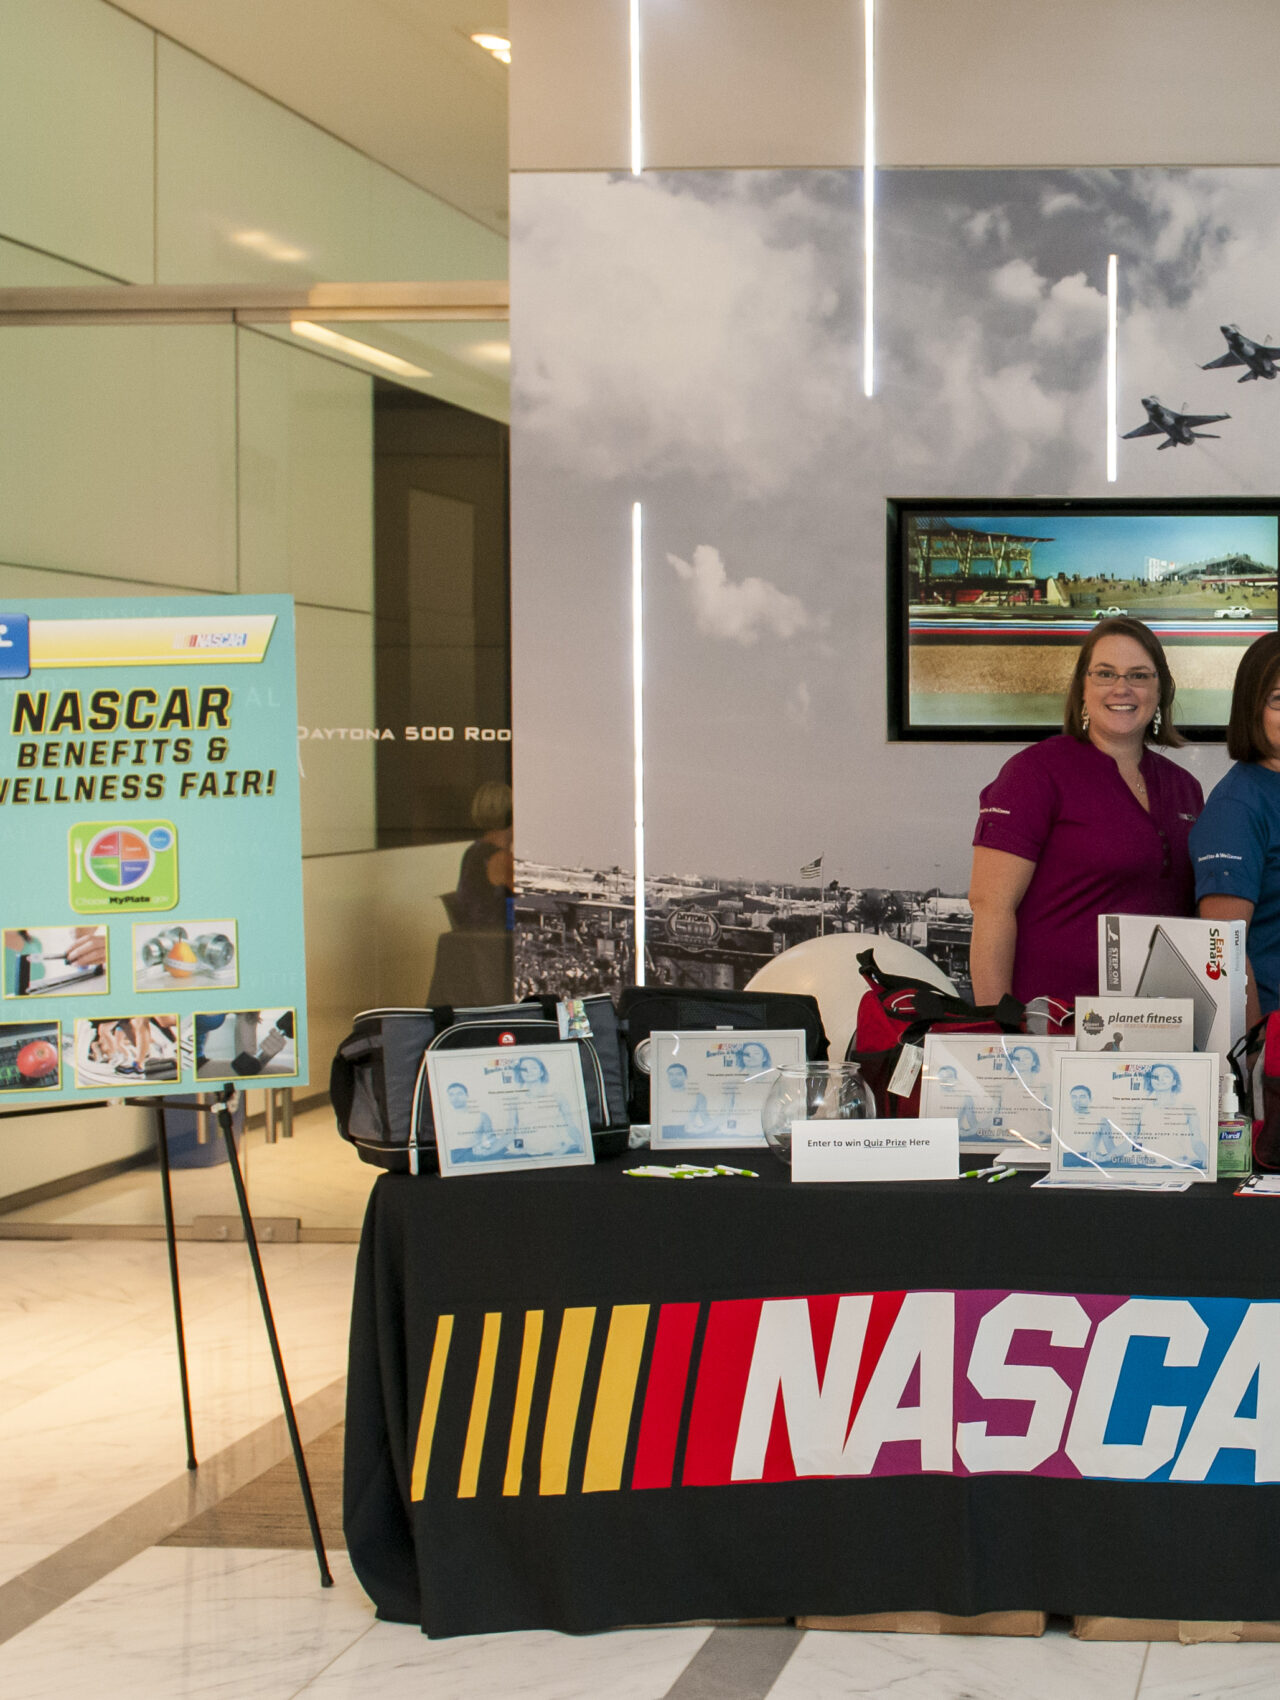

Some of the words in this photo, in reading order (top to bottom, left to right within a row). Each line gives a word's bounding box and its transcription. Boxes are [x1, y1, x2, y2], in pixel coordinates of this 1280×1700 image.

[10, 686, 232, 735] NASCAR
[405, 726, 455, 741] 500
[17, 738, 193, 769] BENEFITS
[207, 737, 229, 763] &
[180, 769, 277, 799] FAIR!
[1209, 928, 1220, 973] Smart
[1216, 938, 1225, 959] Eat
[1108, 1012, 1144, 1025] planet
[1146, 1012, 1183, 1024] fitness
[807, 1139, 831, 1148] Enter
[845, 1139, 861, 1147] win
[863, 1138, 883, 1149] Quiz
[885, 1138, 907, 1147] Prize
[909, 1138, 931, 1147] Here
